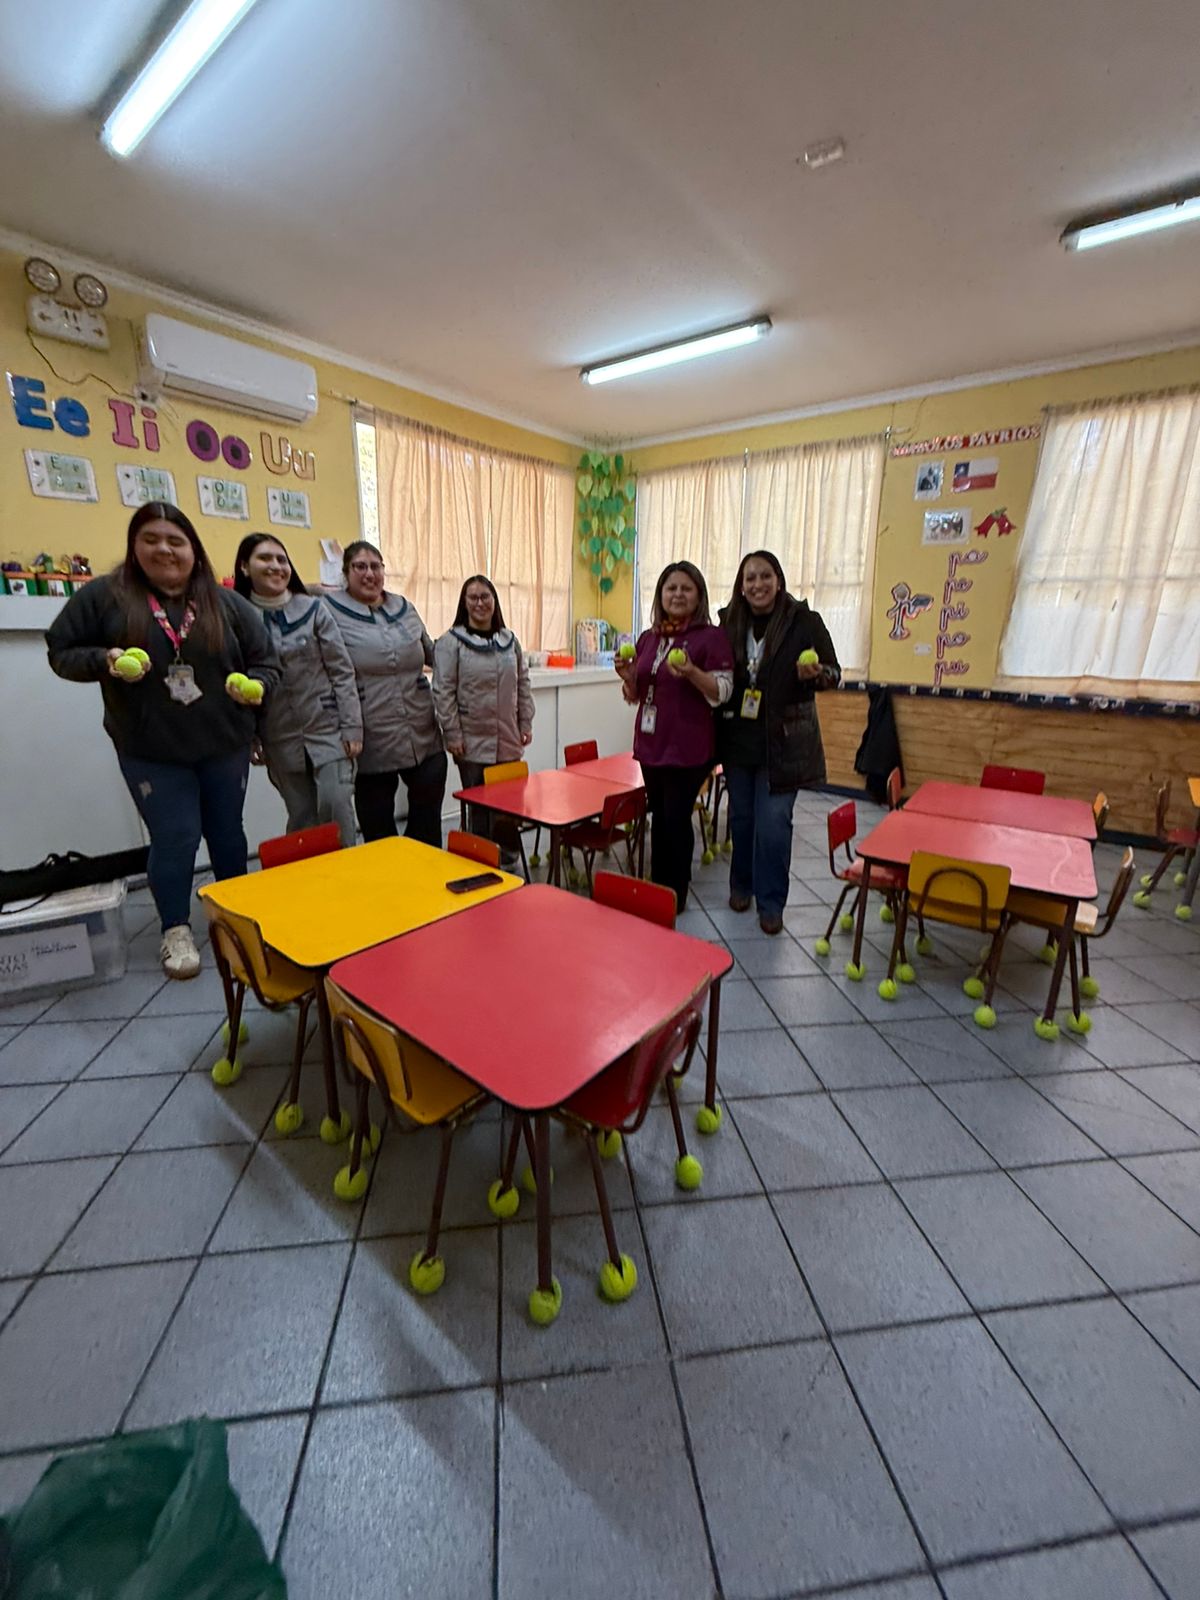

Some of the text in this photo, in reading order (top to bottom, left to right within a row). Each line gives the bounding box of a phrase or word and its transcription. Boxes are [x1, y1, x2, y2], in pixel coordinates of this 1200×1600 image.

[6, 371, 316, 480] Ee Ii Oo Uu
[969, 426, 1040, 448] PATRIOS
